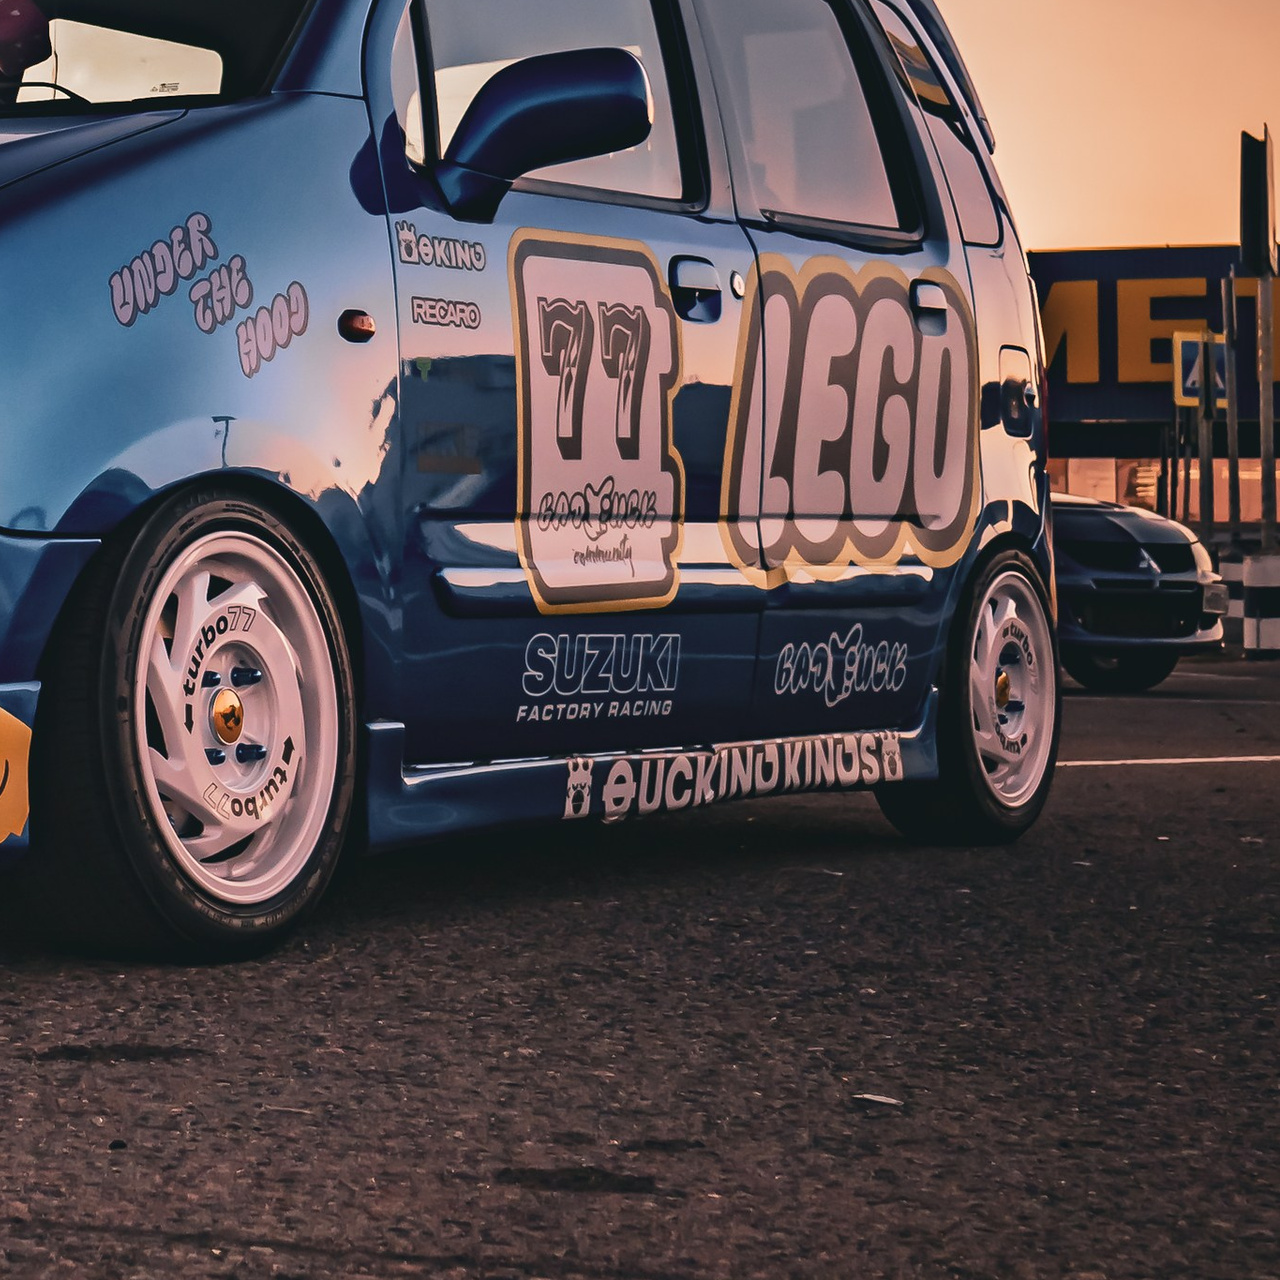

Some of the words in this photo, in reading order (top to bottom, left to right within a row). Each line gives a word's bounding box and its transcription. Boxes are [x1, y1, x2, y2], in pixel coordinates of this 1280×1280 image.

[109, 211, 218, 327] UNDER
[189, 254, 253, 334] THE
[411, 296, 481, 329] RECARO
[236, 281, 309, 378] HOOD
[536, 297, 651, 461] 77
[734, 286, 973, 555] LEGO
[183, 605, 257, 697] turbo77
[521, 632, 681, 697] SUZUKI
[516, 701, 604, 722] FACTORY
[607, 699, 673, 718] RACING
